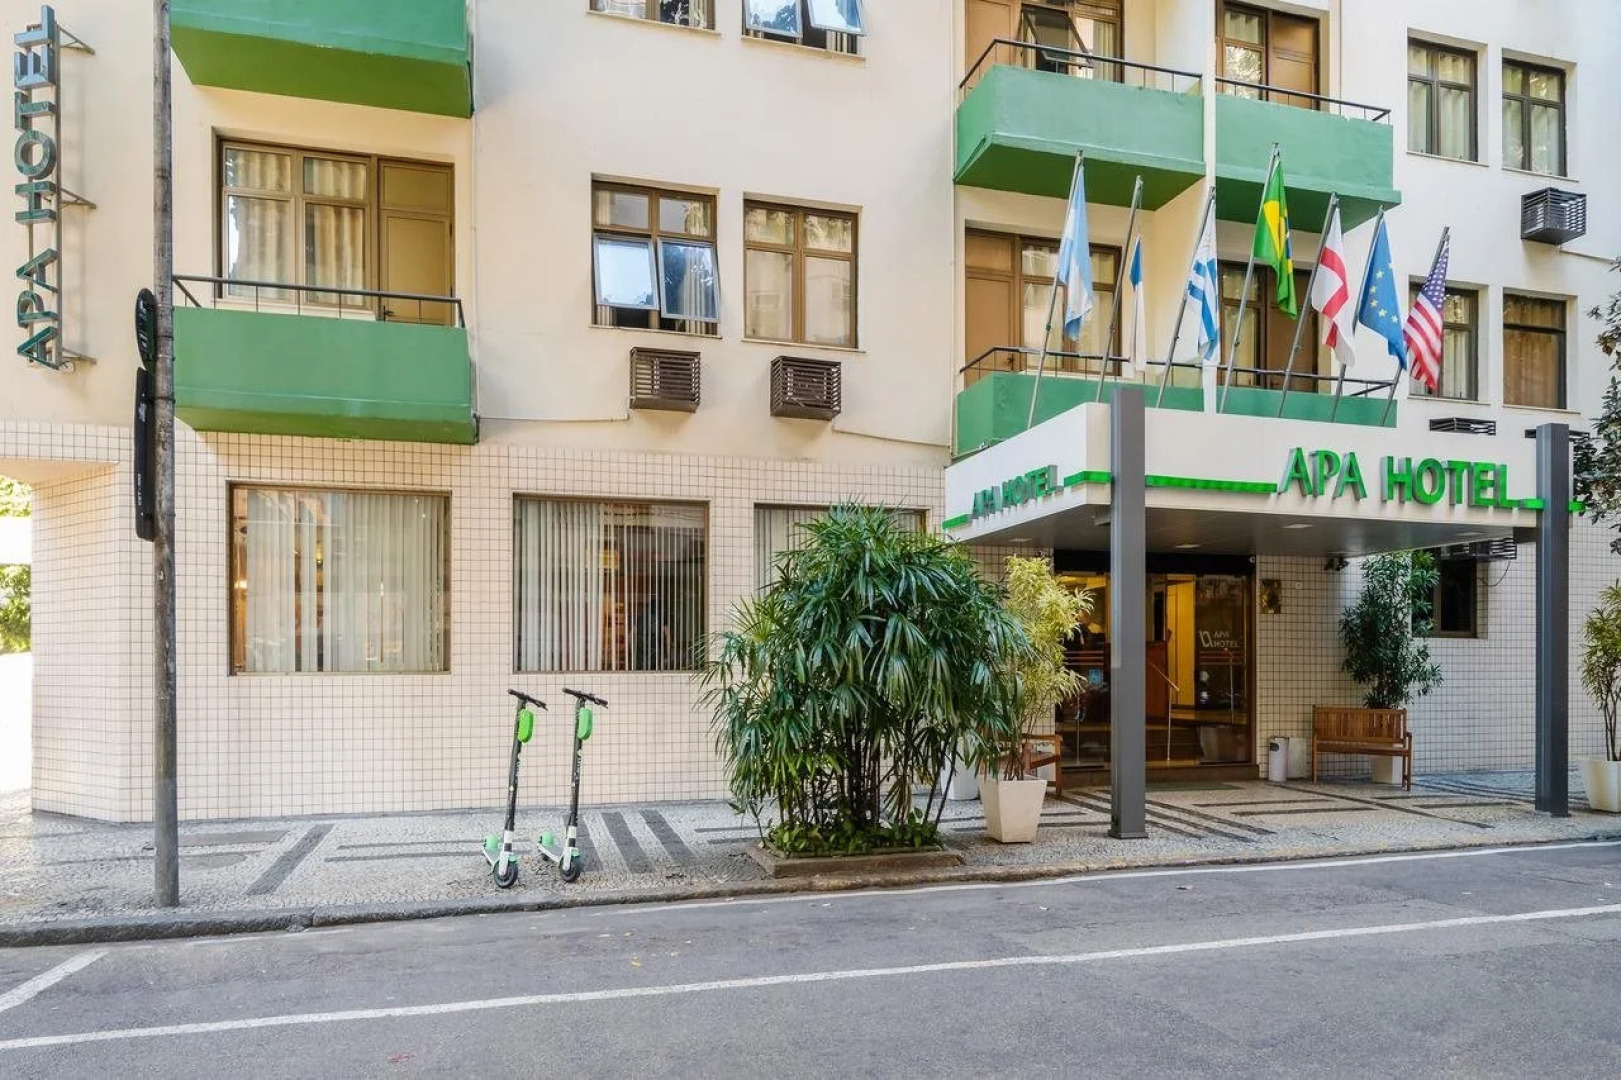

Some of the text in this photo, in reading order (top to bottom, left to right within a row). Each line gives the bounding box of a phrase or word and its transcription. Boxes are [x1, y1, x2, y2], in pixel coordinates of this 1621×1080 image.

[14, 5, 59, 370] APA HOTEL
[1002, 465, 1061, 509] HOTEL
[1278, 446, 1520, 509] APA HOTEL
[1212, 640, 1241, 648] HOTEL
[1213, 631, 1230, 639] APA
